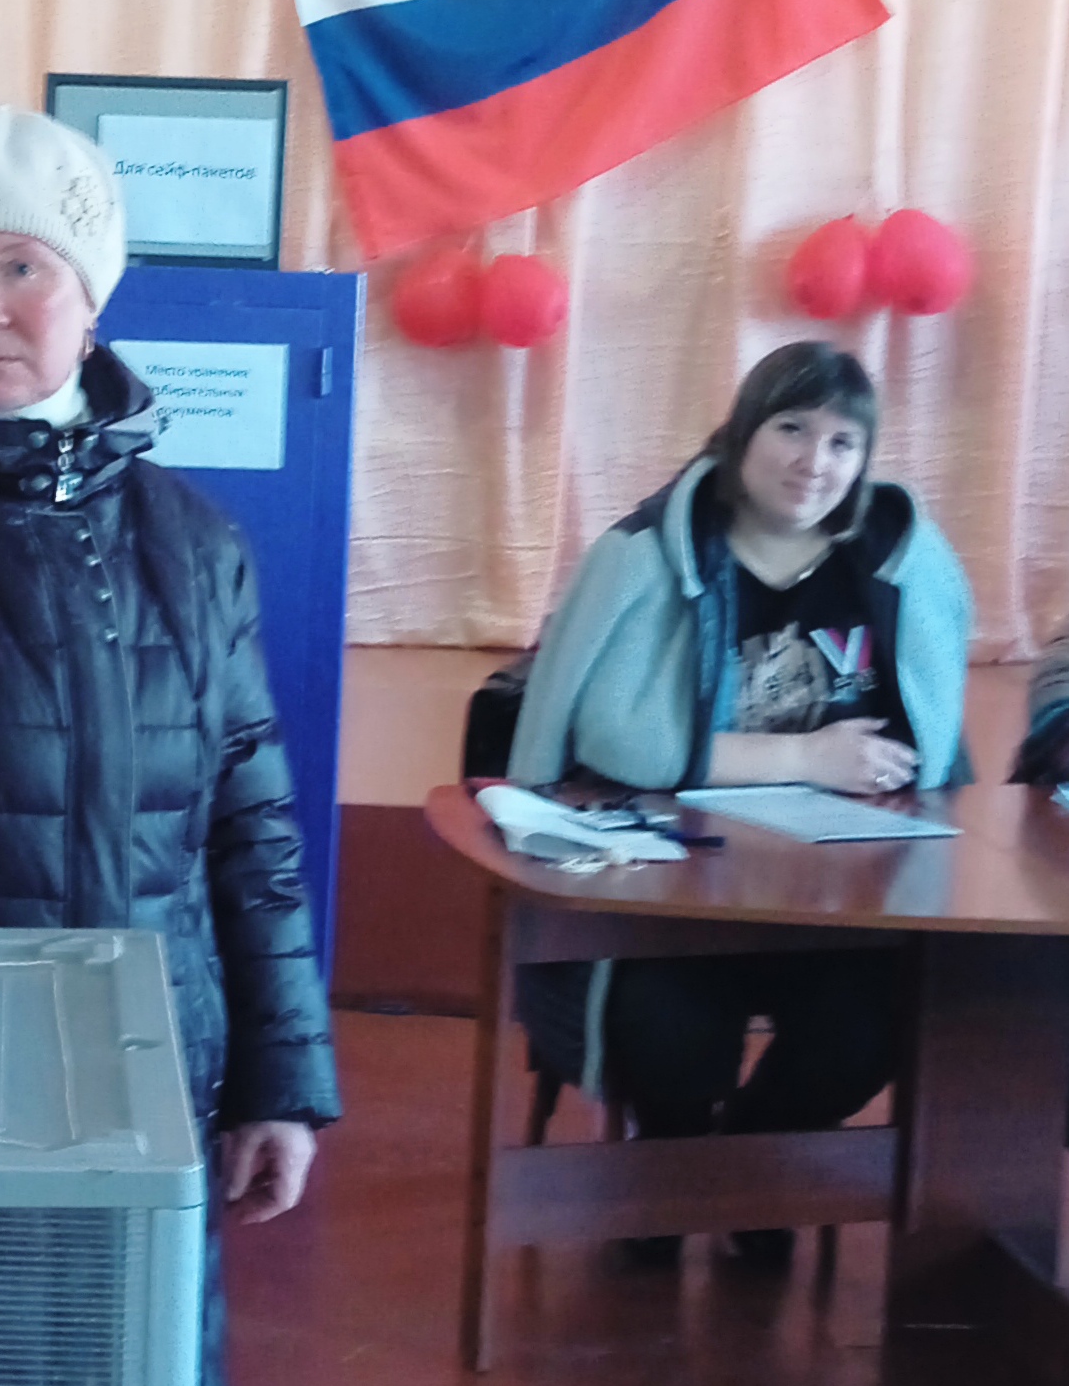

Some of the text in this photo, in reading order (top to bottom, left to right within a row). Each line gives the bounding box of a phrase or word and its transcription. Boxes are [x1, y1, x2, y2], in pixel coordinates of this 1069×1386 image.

[114, 159, 257, 180] Для сейф-пакетов
[145, 365, 185, 377] Место
[150, 384, 245, 397] збирательных
